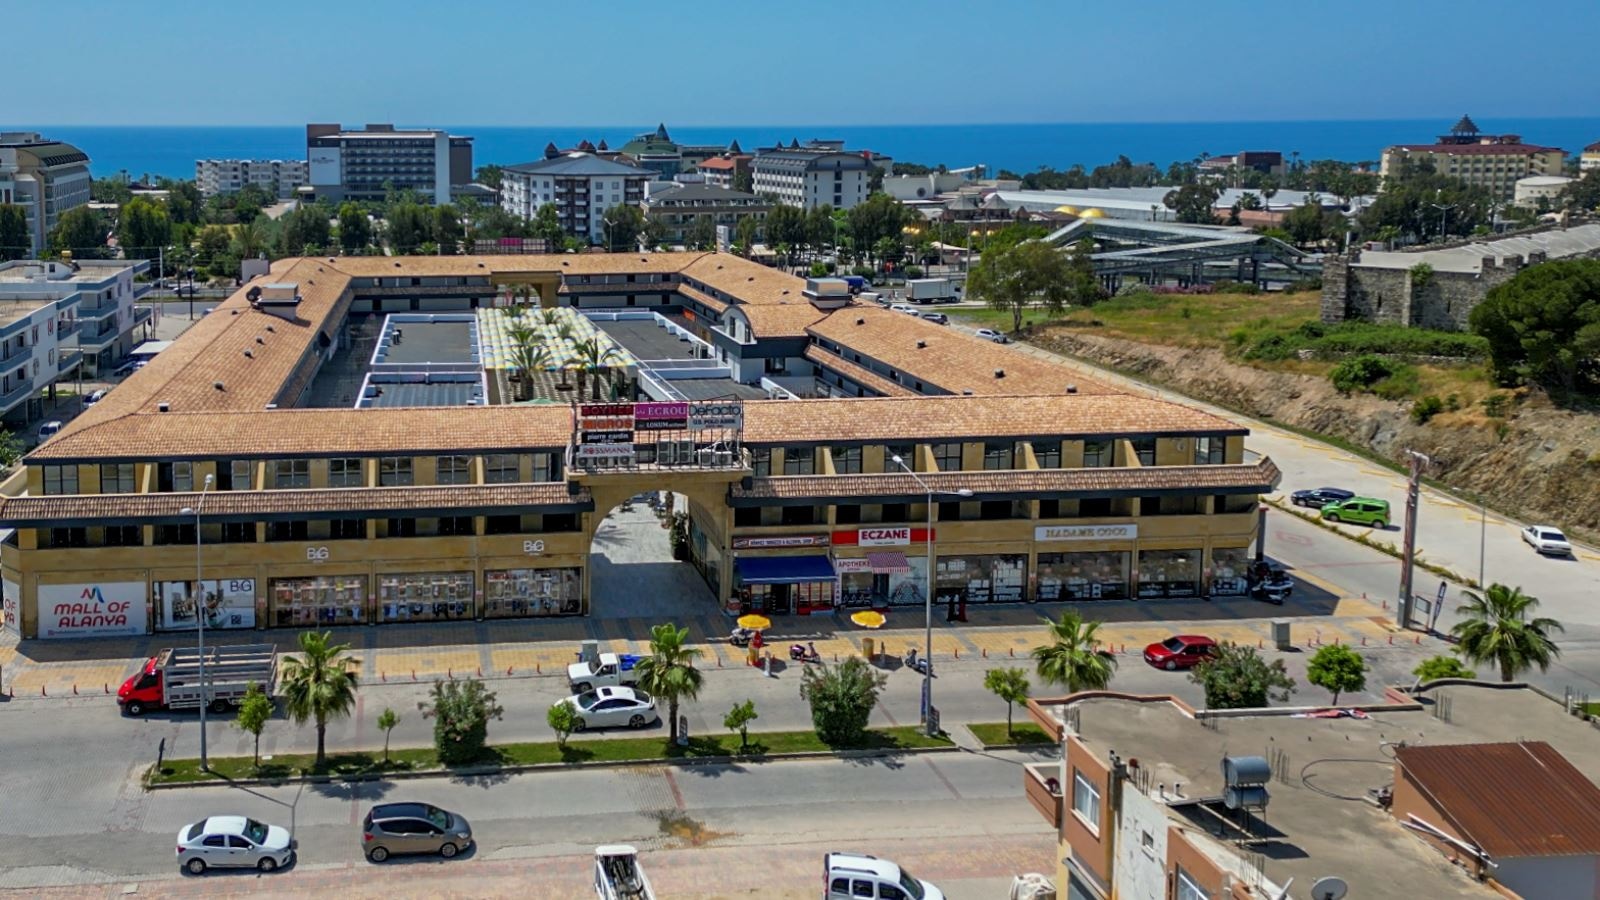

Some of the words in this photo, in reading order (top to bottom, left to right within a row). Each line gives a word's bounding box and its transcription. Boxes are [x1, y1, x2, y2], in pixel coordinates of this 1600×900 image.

[648, 406, 687, 415] ECROU
[583, 447, 631, 455] ROSSMANN
[861, 530, 908, 540] ECZANE
[1046, 528, 1095, 538] MADAME
[1097, 527, 1128, 537] COCO
[54, 603, 102, 615] MALL
[107, 601, 131, 613] OF
[58, 614, 127, 628] ALANYA
